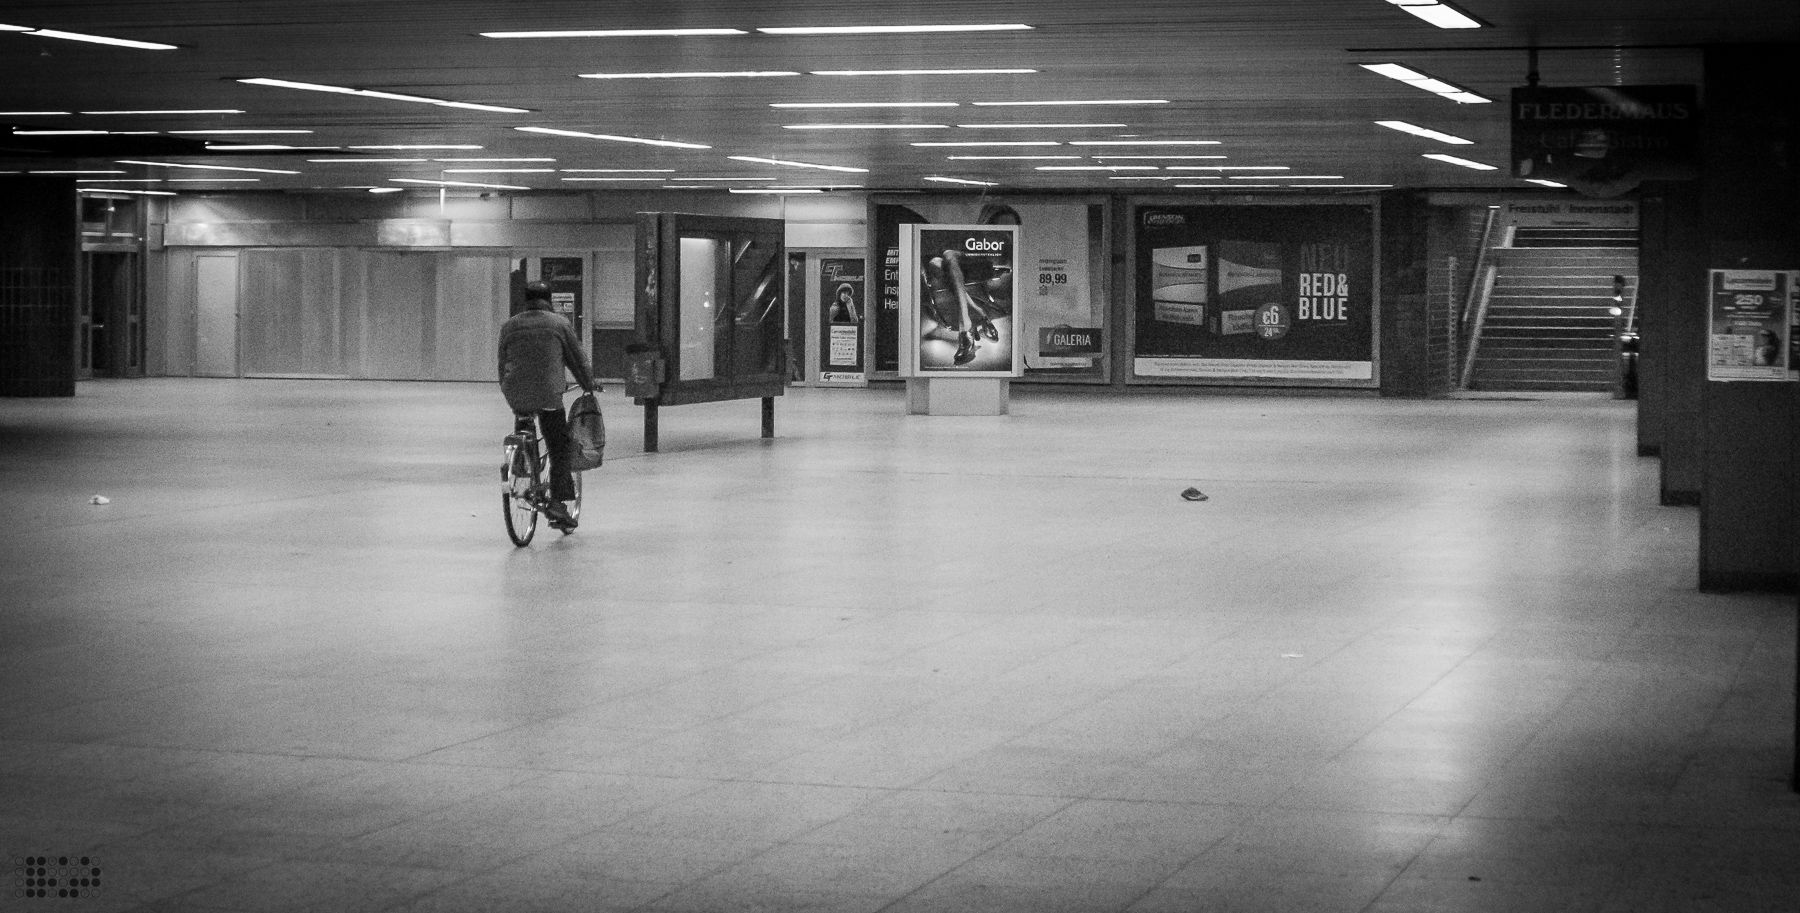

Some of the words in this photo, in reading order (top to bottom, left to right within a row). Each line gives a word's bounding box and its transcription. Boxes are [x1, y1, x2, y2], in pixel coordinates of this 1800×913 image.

[1519, 103, 1689, 119] FLEDERMAUS
[1569, 203, 1633, 213] Innenstadt
[965, 238, 1004, 251] Gabor
[1039, 273, 1067, 286] 89,99
[1300, 273, 1348, 297] RED&
[1735, 294, 1763, 305] 250
[1299, 297, 1348, 320] BLUE
[1054, 334, 1091, 346] GALERIA
